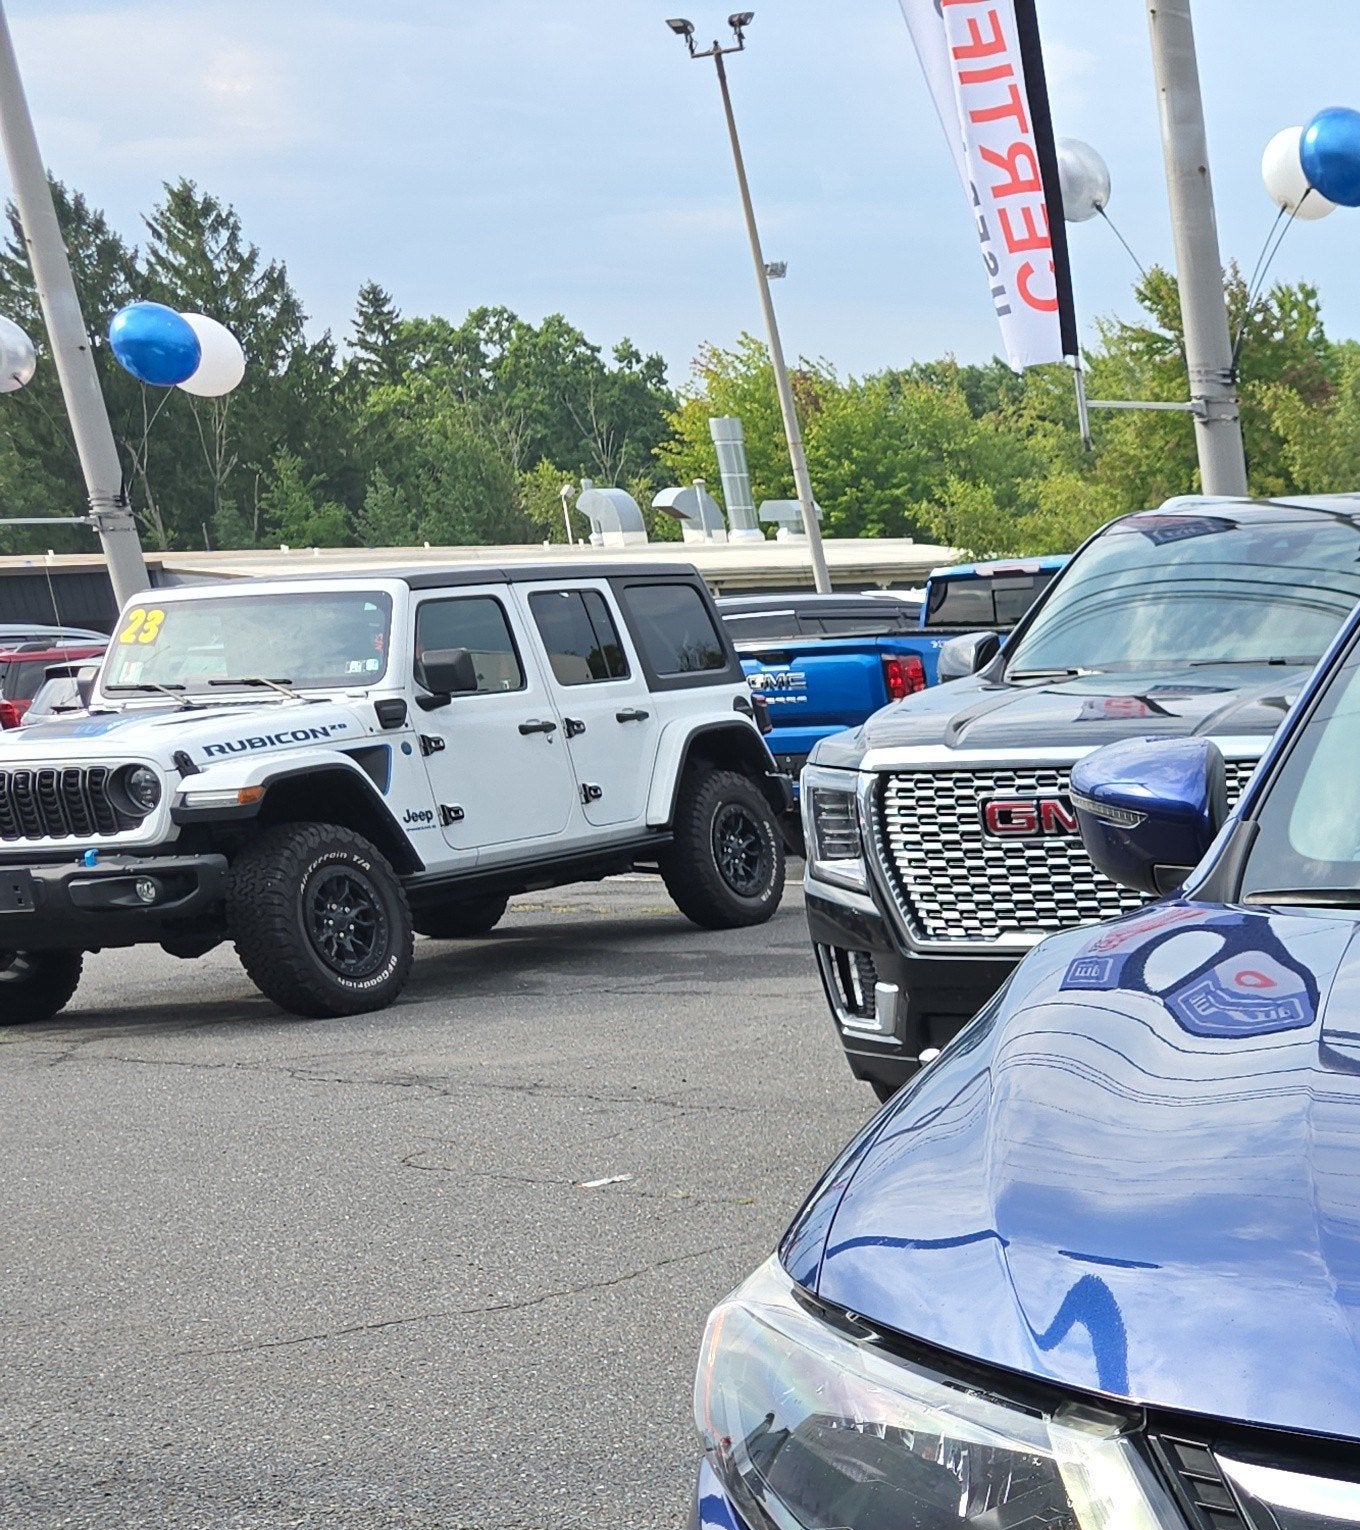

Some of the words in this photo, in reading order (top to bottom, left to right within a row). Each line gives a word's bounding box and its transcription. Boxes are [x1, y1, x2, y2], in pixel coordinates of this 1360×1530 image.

[119, 608, 165, 644] 23
[202, 726, 331, 757] RUBICON
[403, 809, 433, 823] Jeep
[984, 799, 1079, 836] GM
